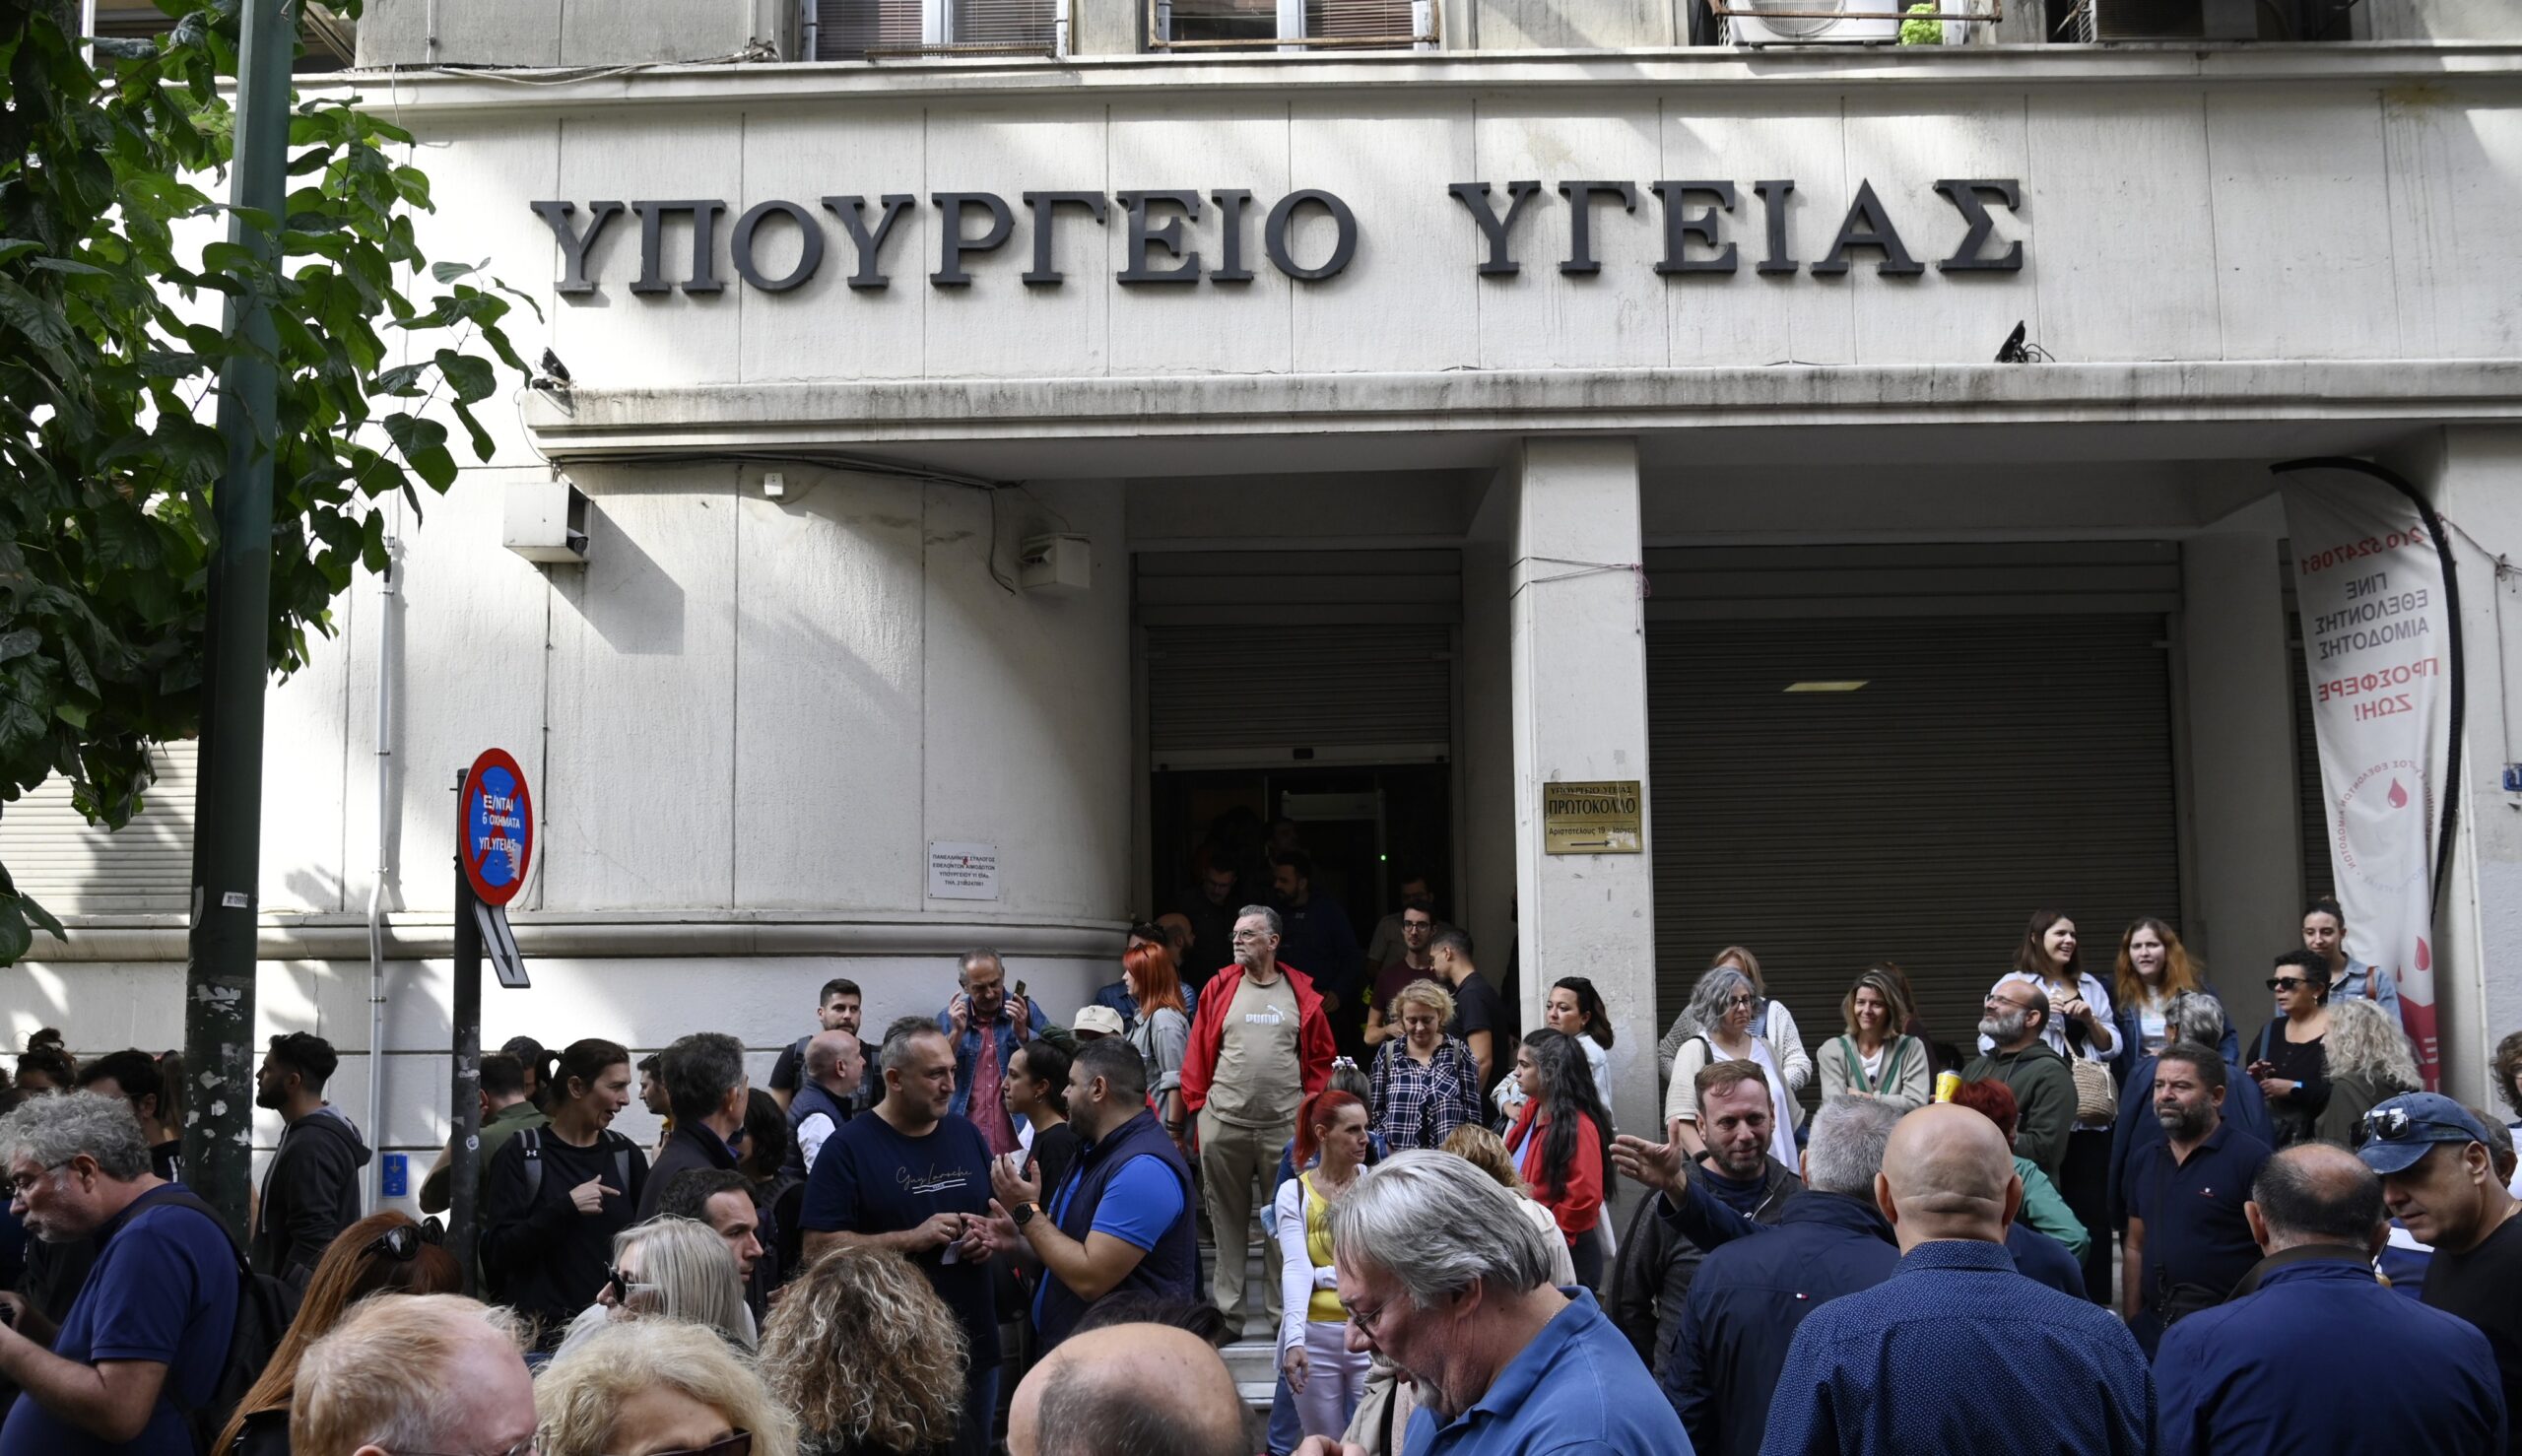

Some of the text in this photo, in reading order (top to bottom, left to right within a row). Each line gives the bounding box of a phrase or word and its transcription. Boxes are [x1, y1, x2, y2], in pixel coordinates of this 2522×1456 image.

[531, 177, 2024, 295] ΥΠΟΥΡΓΕΙΟ ΥΓΕΙΑΣ
[1549, 798, 1635, 815] ΠΡΩΤΟΚΟΛΛΟ
[489, 815, 520, 829] ΟΧΗΜΑΤΑ
[1245, 1014, 1280, 1025] PUMA
